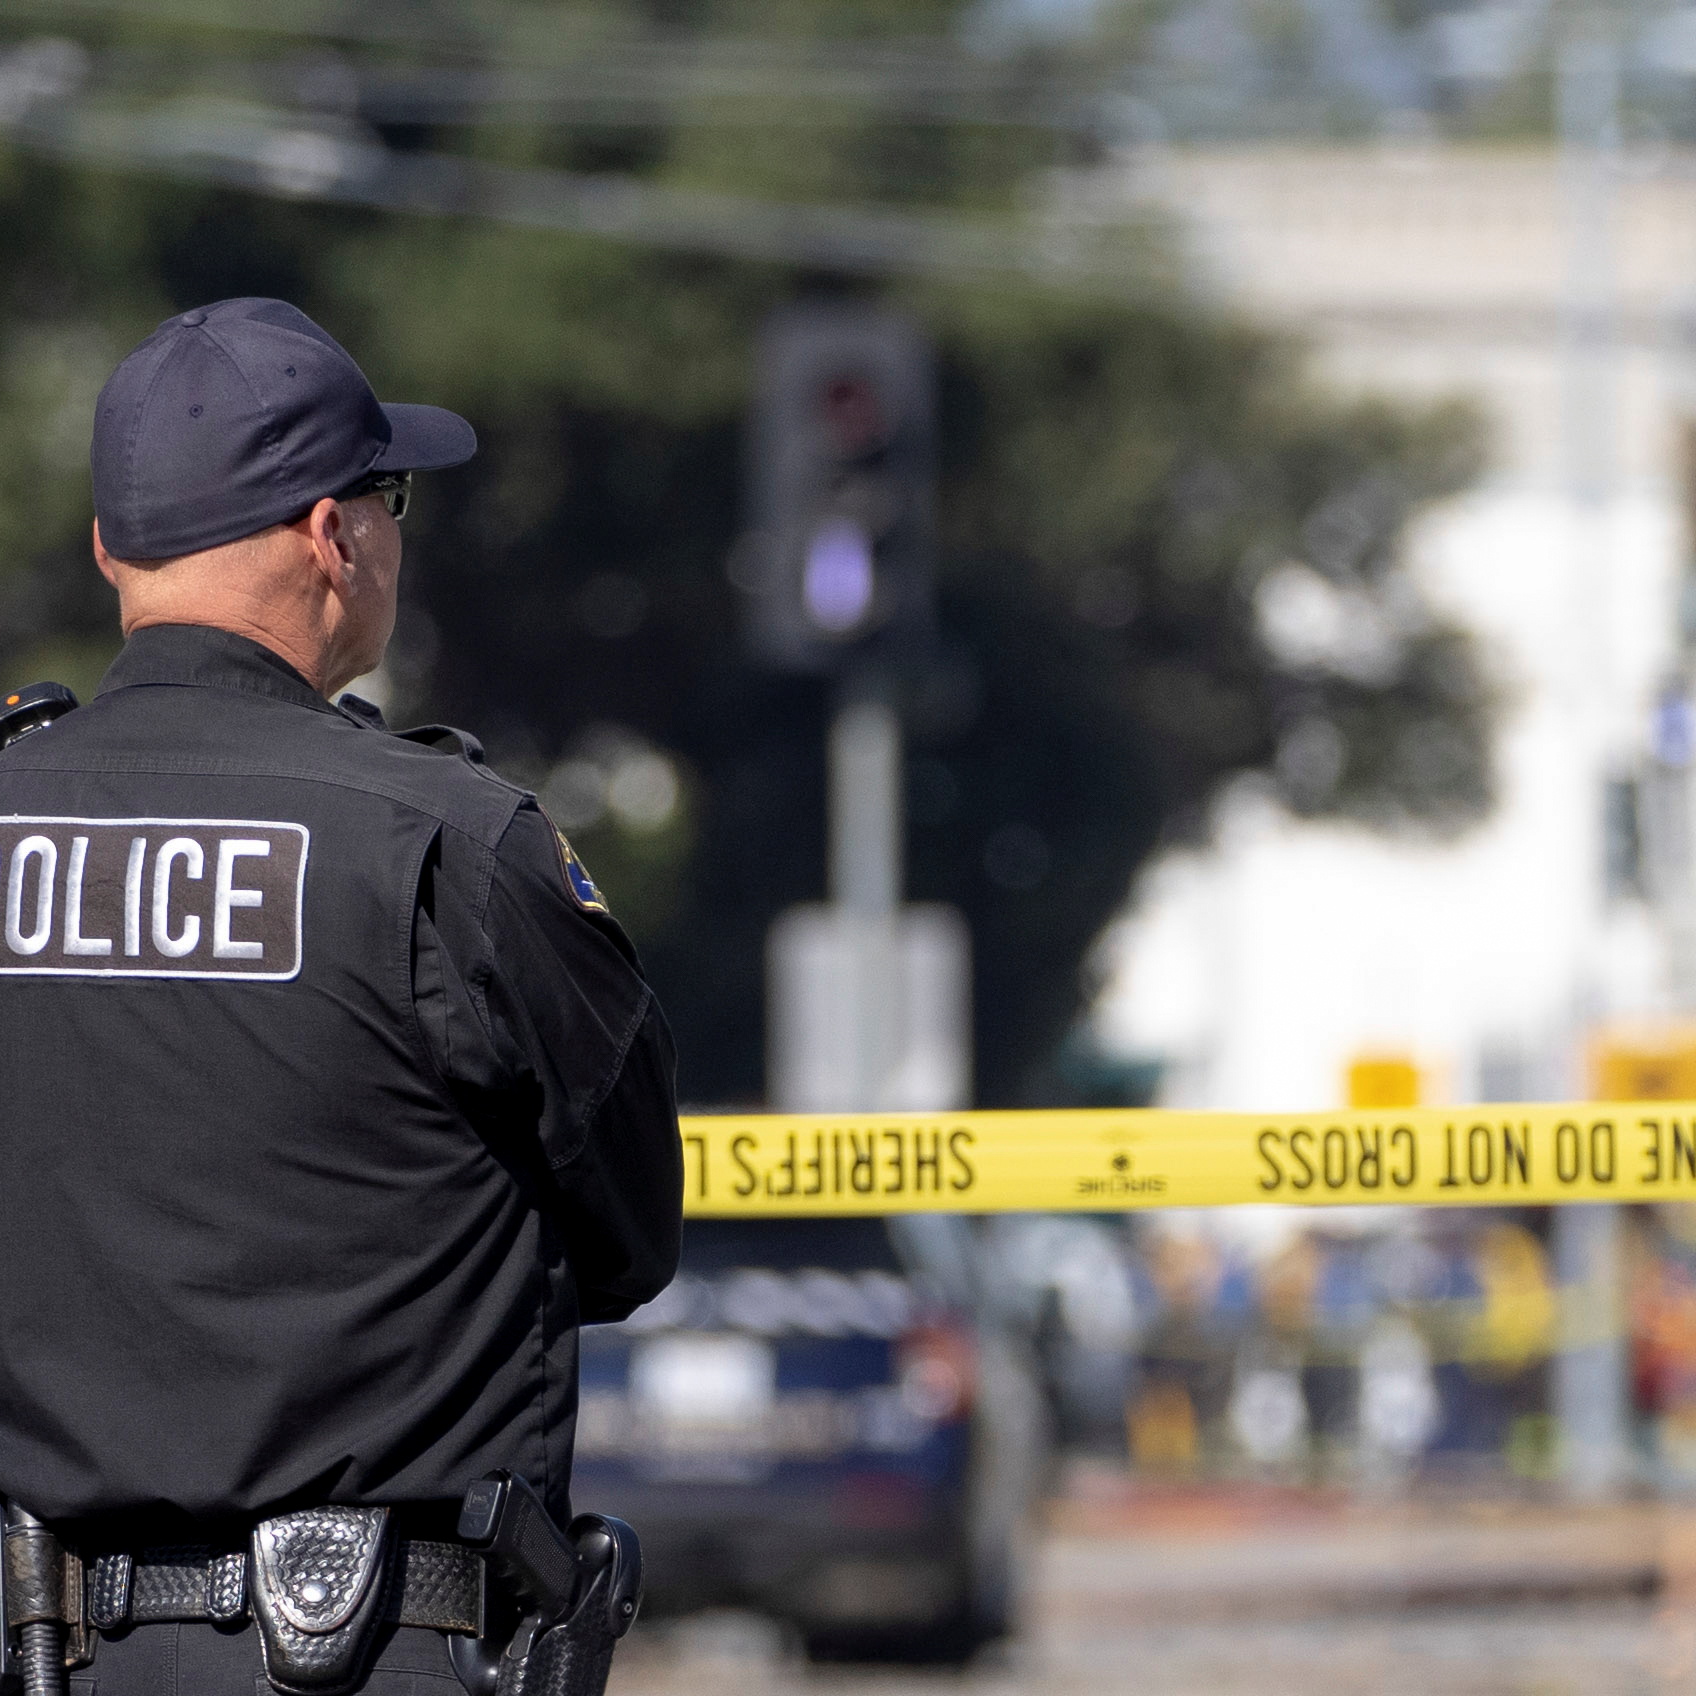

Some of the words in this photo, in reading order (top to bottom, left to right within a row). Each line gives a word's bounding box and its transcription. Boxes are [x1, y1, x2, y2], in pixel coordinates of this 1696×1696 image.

[732, 1131, 975, 1198] SHERIFF'S
[1258, 1128, 1417, 1192] CROSS
[1439, 1126, 1530, 1188] NOT
[1556, 1123, 1615, 1184] DO
